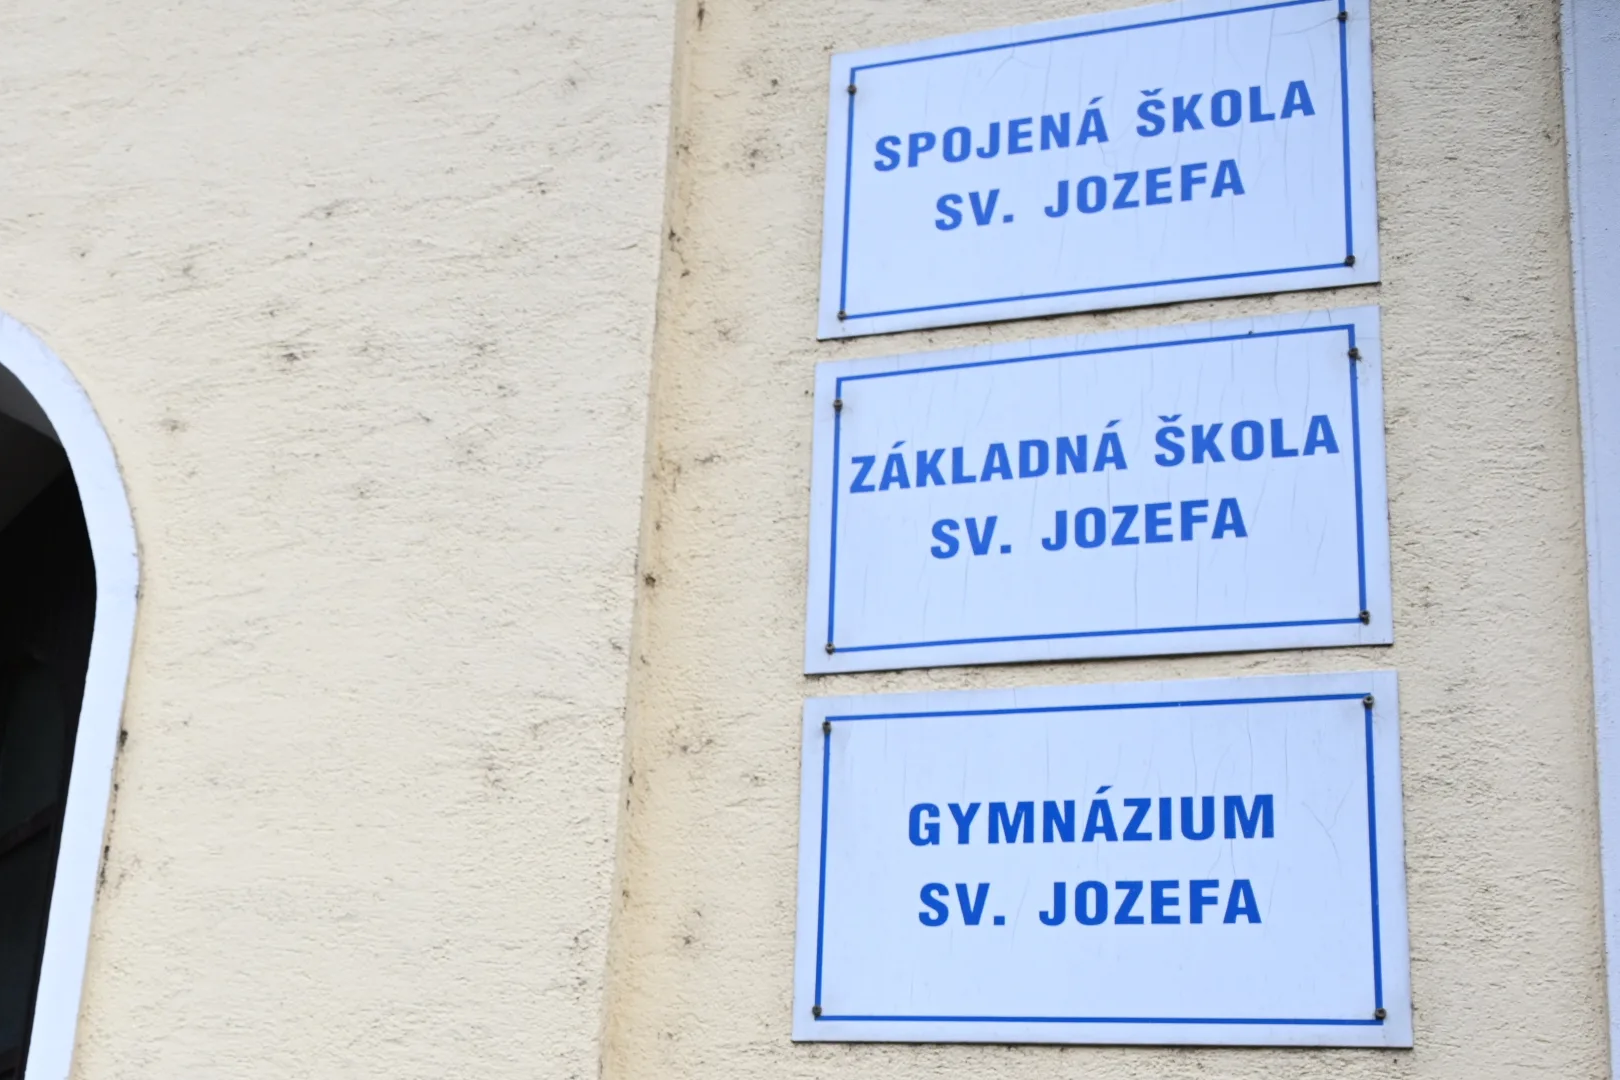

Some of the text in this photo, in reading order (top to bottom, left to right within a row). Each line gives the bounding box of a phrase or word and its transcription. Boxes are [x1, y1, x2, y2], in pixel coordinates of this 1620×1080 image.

[874, 79, 1316, 172] SPOJENÁ ŠKOLA
[935, 158, 1246, 231] SV. JOZEFA
[849, 413, 1340, 494] ZÁKLADNÁ ŠKOLA
[930, 497, 1248, 560] SV. JOZEFA
[908, 785, 1275, 847] GYMNÁZIUM
[918, 878, 1263, 927] SV. JOZEFA
